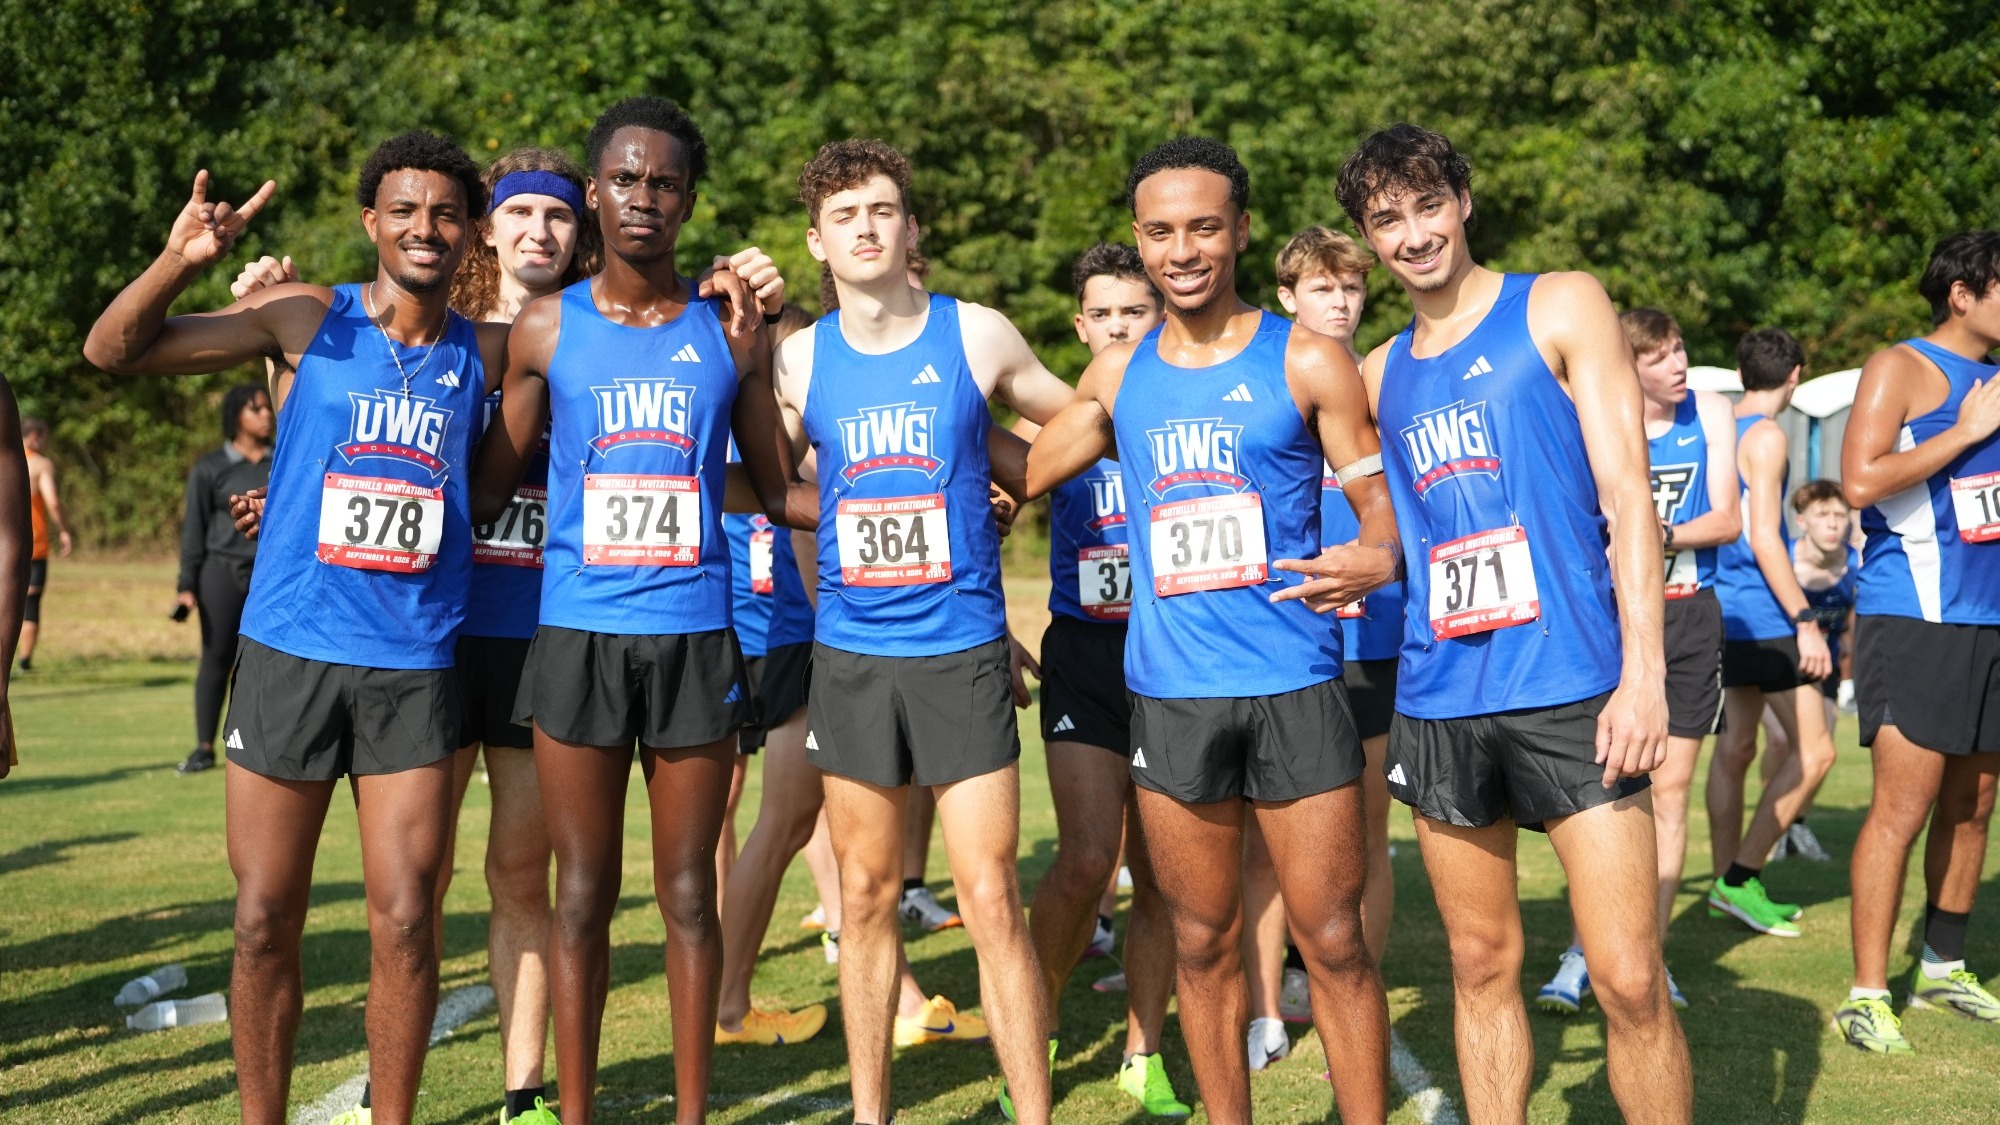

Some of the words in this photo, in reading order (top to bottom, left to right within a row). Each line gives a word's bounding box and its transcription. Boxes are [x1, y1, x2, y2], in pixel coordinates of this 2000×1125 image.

[600, 383, 686, 435] UWG
[356, 396, 444, 455] UWG
[845, 407, 927, 463] UWG
[604, 432, 685, 445] WOLVES
[1405, 408, 1487, 475] UWG
[353, 445, 435, 466] WOLVES
[1153, 423, 1235, 475] UWG
[851, 458, 929, 474] WOLVES
[1420, 461, 1490, 486] WOLVES
[337, 478, 382, 491] FOOTHILLS
[384, 483, 435, 498] INVITATIONAL
[596, 479, 637, 488] FOOTHILLS
[639, 479, 691, 490] INVITATIONAL
[1160, 473, 1236, 487] WOLVES
[517, 488, 547, 498] VITATION
[846, 503, 882, 512] FOOTHILLS
[884, 499, 936, 511] INVITATIONAL
[1159, 503, 1196, 518] FOOTHILLS
[345, 496, 423, 549] 378
[606, 494, 680, 542] 374
[857, 515, 929, 564] 364
[1170, 515, 1243, 568] 370
[1436, 542, 1464, 559] FOOTHILLS
[1465, 531, 1516, 550] INVITATIONAL
[346, 551, 384, 562] SEPTEMBER
[475, 549, 509, 557] SEPTEMBER
[608, 549, 645, 557] SEPTEMBER
[673, 554, 694, 562] STATE
[864, 570, 898, 578] SEPTEMBER
[1099, 562, 1132, 601] 37
[1241, 571, 1263, 581] STATE
[1446, 552, 1508, 611] 371
